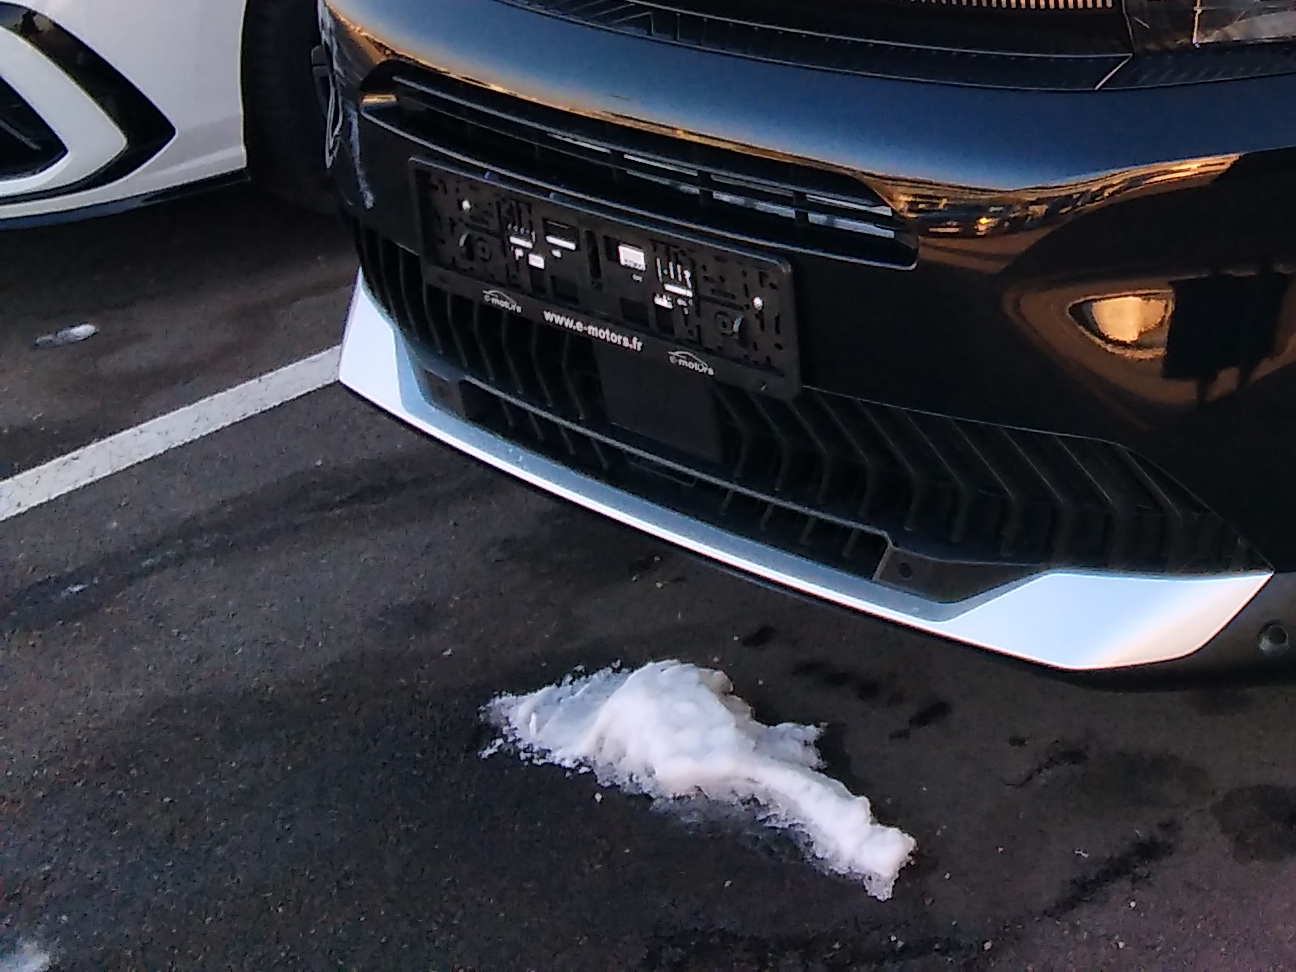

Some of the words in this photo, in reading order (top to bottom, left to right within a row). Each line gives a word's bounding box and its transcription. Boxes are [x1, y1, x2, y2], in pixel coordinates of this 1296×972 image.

[482, 294, 522, 313] e-motors
[542, 310, 643, 352] www.e-motors.fr
[669, 355, 715, 376] e-motors
